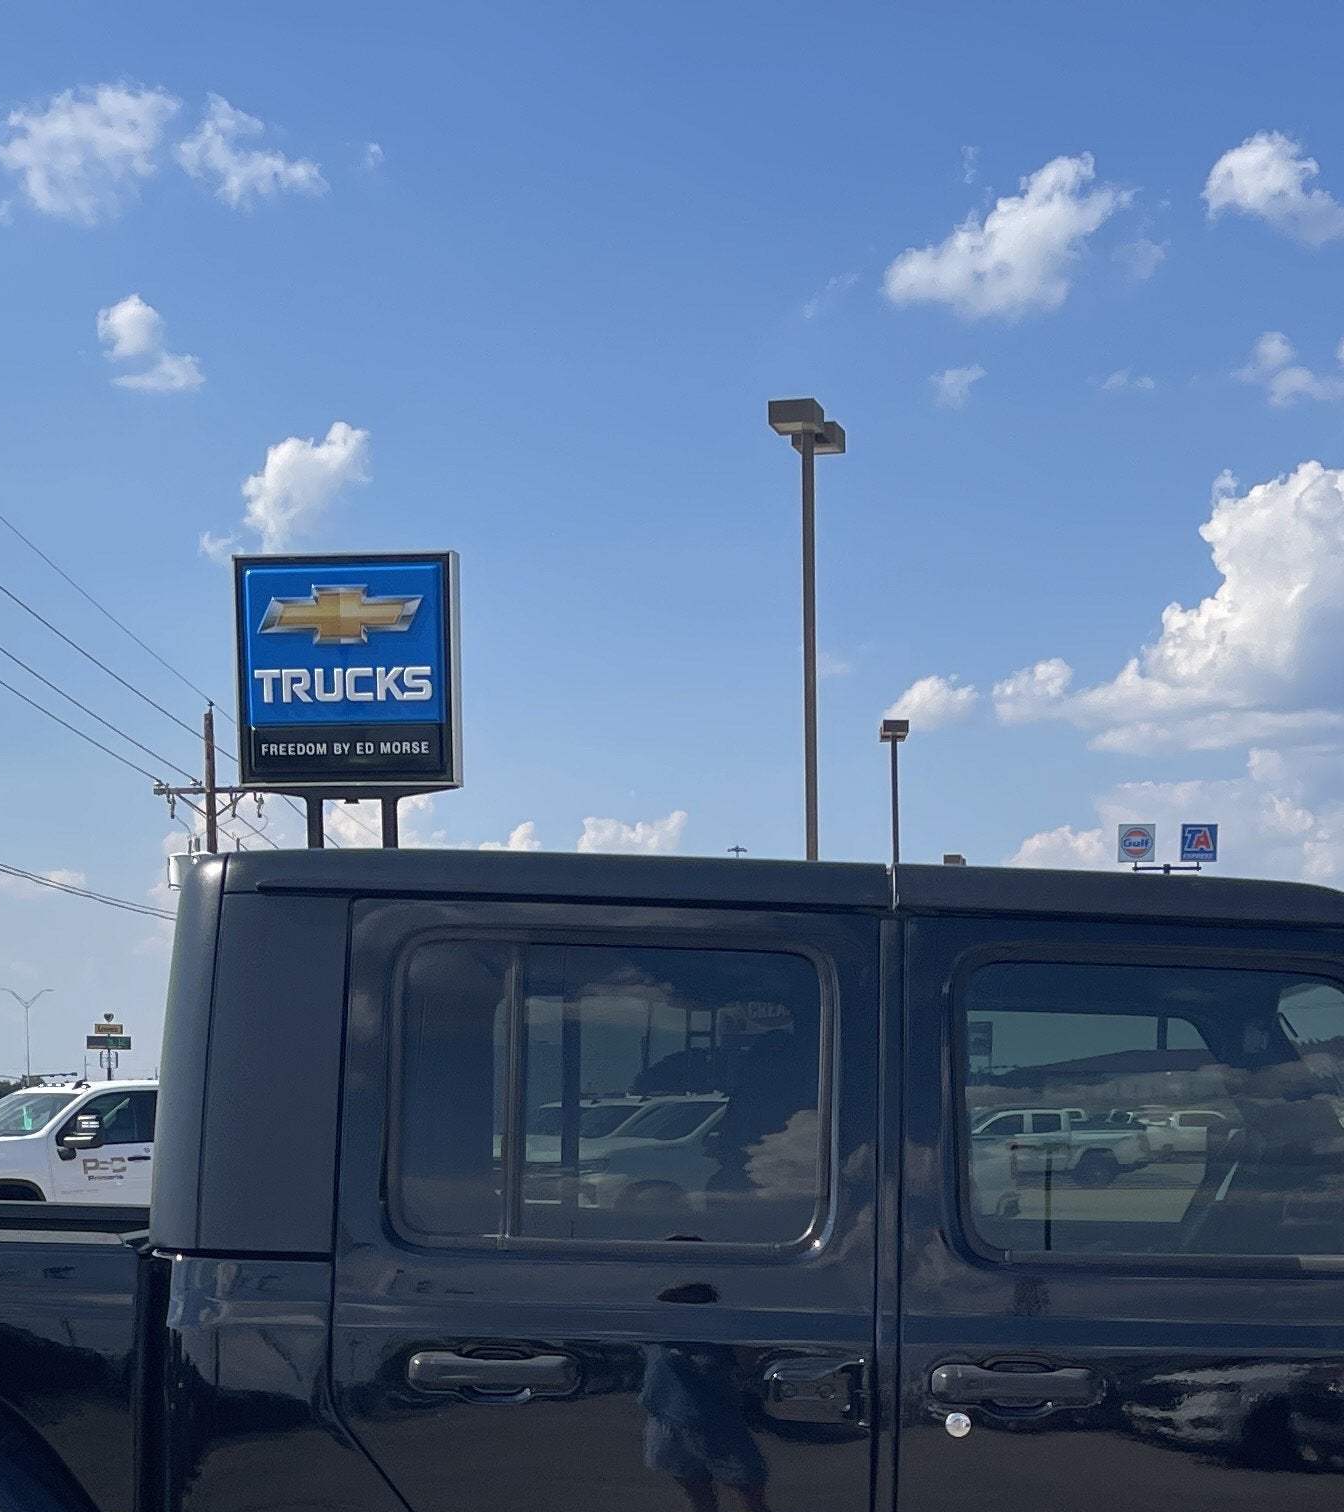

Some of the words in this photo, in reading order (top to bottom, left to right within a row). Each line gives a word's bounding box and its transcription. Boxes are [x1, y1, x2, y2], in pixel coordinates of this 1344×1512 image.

[254, 666, 433, 703] TRUCKS
[261, 743, 327, 756] FREEDOM
[333, 743, 350, 755] BY
[356, 742, 374, 755] ED
[380, 741, 430, 754] MORSE
[1123, 838, 1150, 849] Gulf
[1184, 827, 1214, 851] TA
